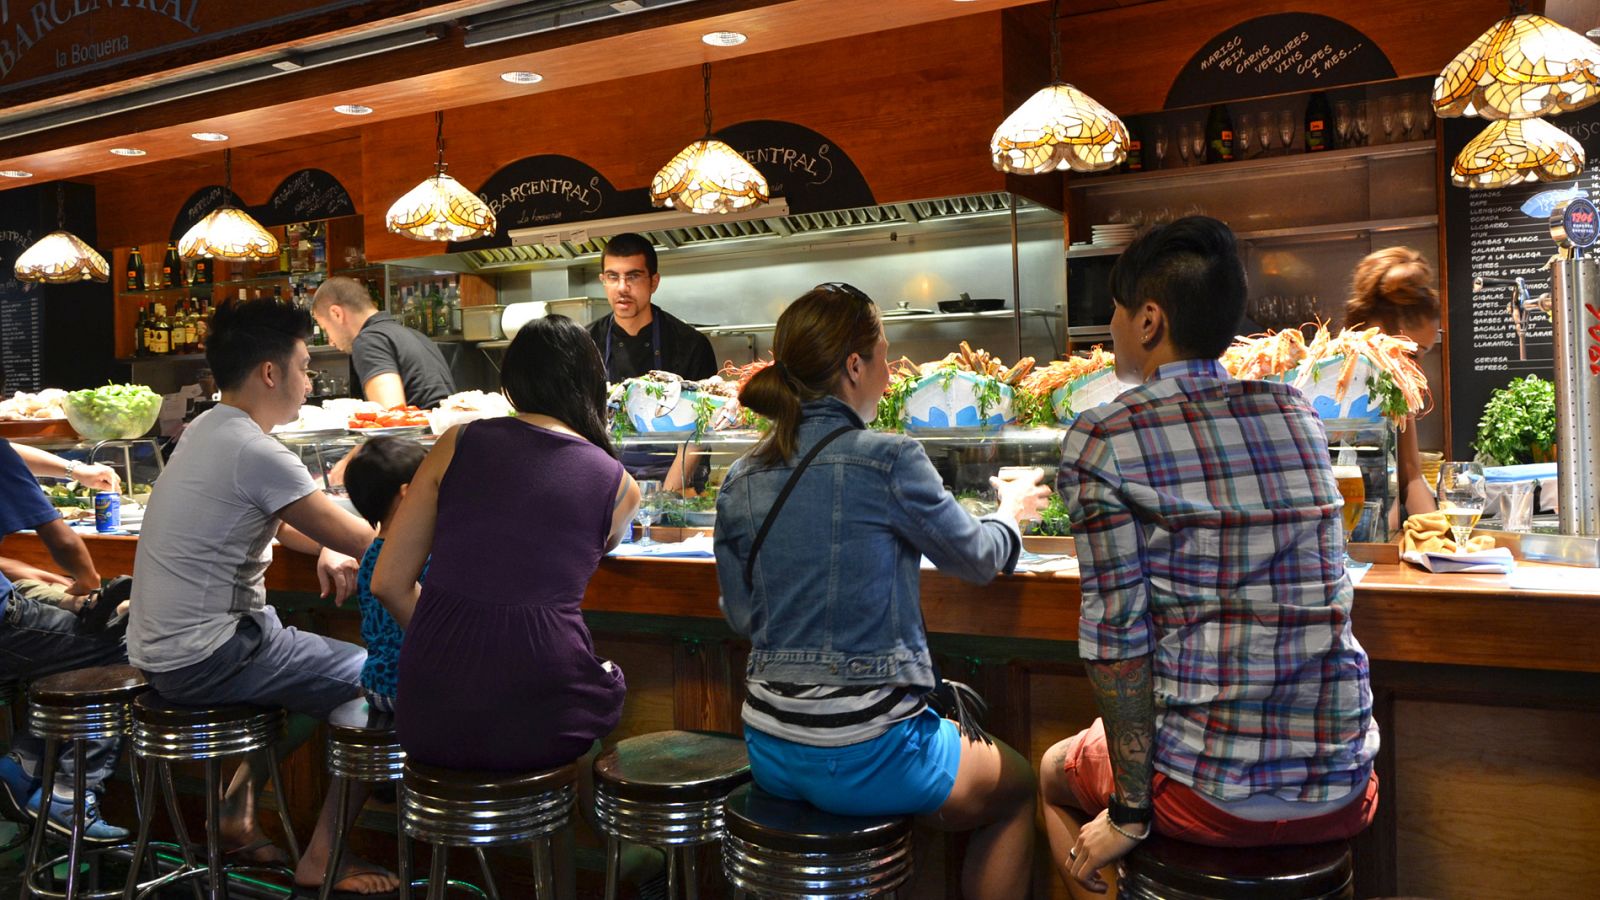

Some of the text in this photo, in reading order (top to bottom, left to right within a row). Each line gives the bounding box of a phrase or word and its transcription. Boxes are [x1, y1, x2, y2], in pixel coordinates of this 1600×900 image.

[56, 35, 129, 69] la Boqueria
[1200, 35, 1243, 71] MARISC
[1254, 31, 1310, 75] VERDURES
[1218, 47, 1246, 71] PEIX
[1235, 44, 1271, 75] CARNS
[1274, 51, 1304, 75] VINS
[1296, 44, 1334, 75] COPES
[1571, 211, 1594, 224] 1906
[1471, 236, 1539, 247] GAMBAS PALAMOS
[1471, 246, 1506, 255] CALAMAR
[1471, 254, 1486, 262] POP
[1495, 253, 1505, 261] LA
[1506, 251, 1541, 260] GALLEGA
[1471, 269, 1500, 278] OSTRAS
[1472, 293, 1504, 301] CIGALAS
[1473, 325, 1506, 333] BACALLA
[1473, 332, 1504, 340] ANILLOS
[1505, 331, 1516, 339] DE
[1474, 356, 1508, 364] CERVESA
